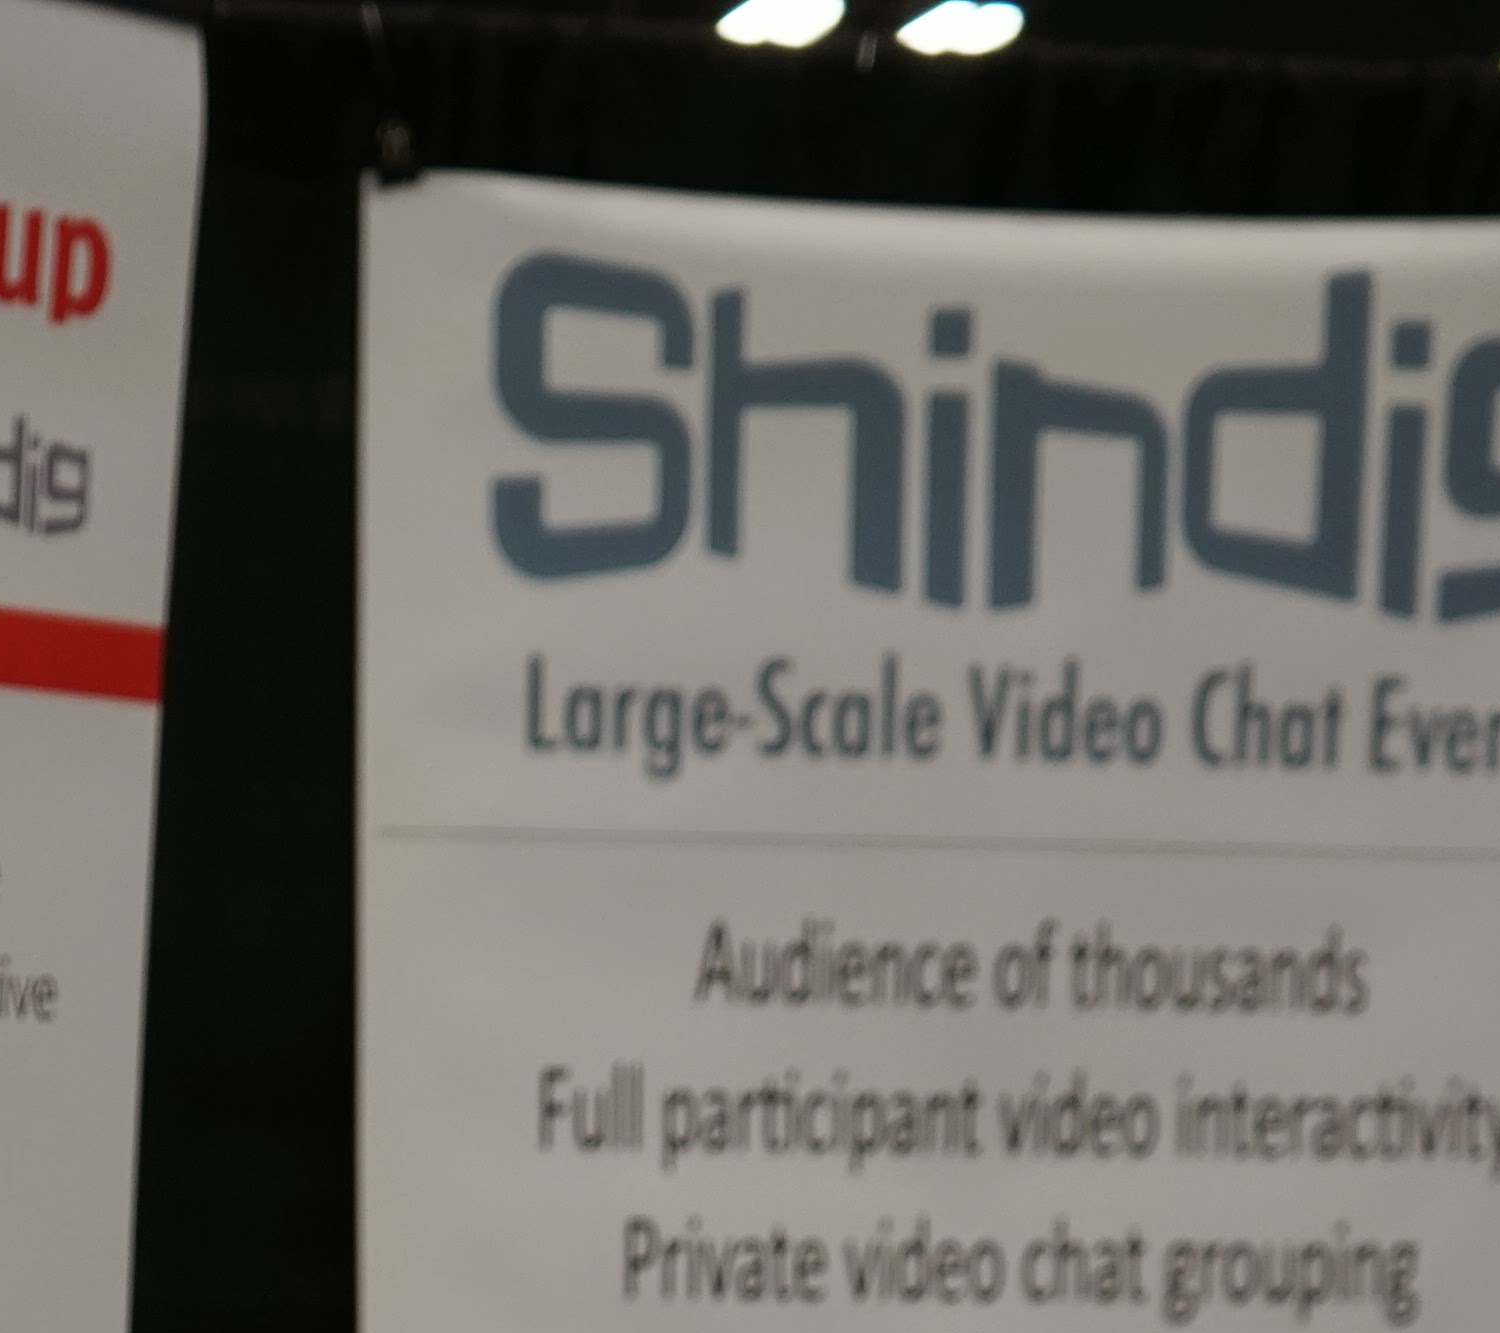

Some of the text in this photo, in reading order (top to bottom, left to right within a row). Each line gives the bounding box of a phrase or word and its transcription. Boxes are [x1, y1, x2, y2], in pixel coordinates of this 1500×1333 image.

[524, 652, 946, 781] Large-Scale
[966, 658, 1165, 768] Video
[1189, 663, 1346, 772] Chat
[693, 917, 1369, 1017] Audience of thousands
[537, 1063, 645, 1154] Full
[660, 1072, 985, 1171] participant
[997, 1072, 1161, 1160] video
[622, 1214, 1421, 1330] Private video chat grouping
